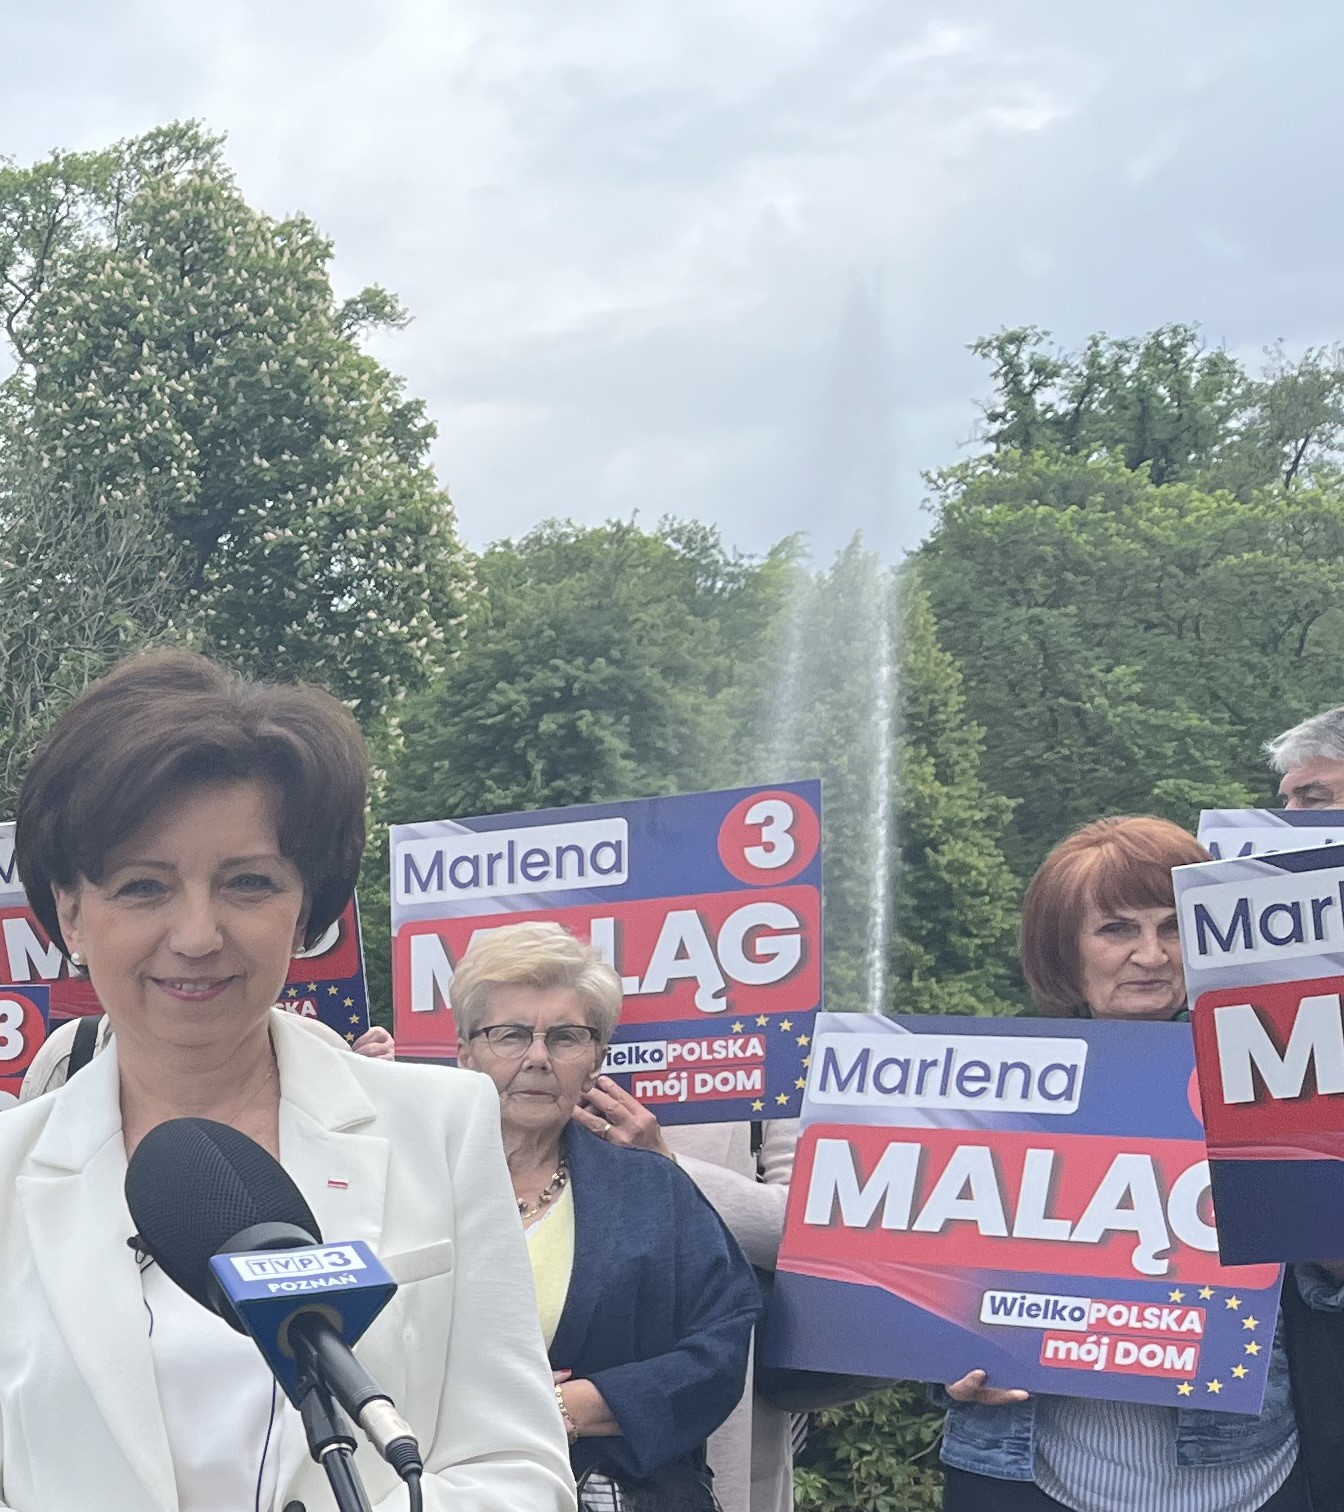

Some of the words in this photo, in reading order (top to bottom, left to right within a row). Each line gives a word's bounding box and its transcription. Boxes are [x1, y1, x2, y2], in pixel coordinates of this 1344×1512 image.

[744, 800, 795, 869] 3
[403, 839, 622, 894] Marlena
[607, 1037, 764, 1066] ielkoPOLSKA
[636, 1072, 687, 1102] mój
[695, 1069, 761, 1094] DOM
[818, 1046, 1078, 1102] Marlena
[251, 1259, 312, 1272] TVP
[324, 1251, 351, 1266] 3
[268, 1273, 357, 1292] POZNAŃ
[990, 1296, 1203, 1333] WielkoPOLSKA
[1046, 1336, 1106, 1370] mój
[1115, 1343, 1196, 1371] DOM
